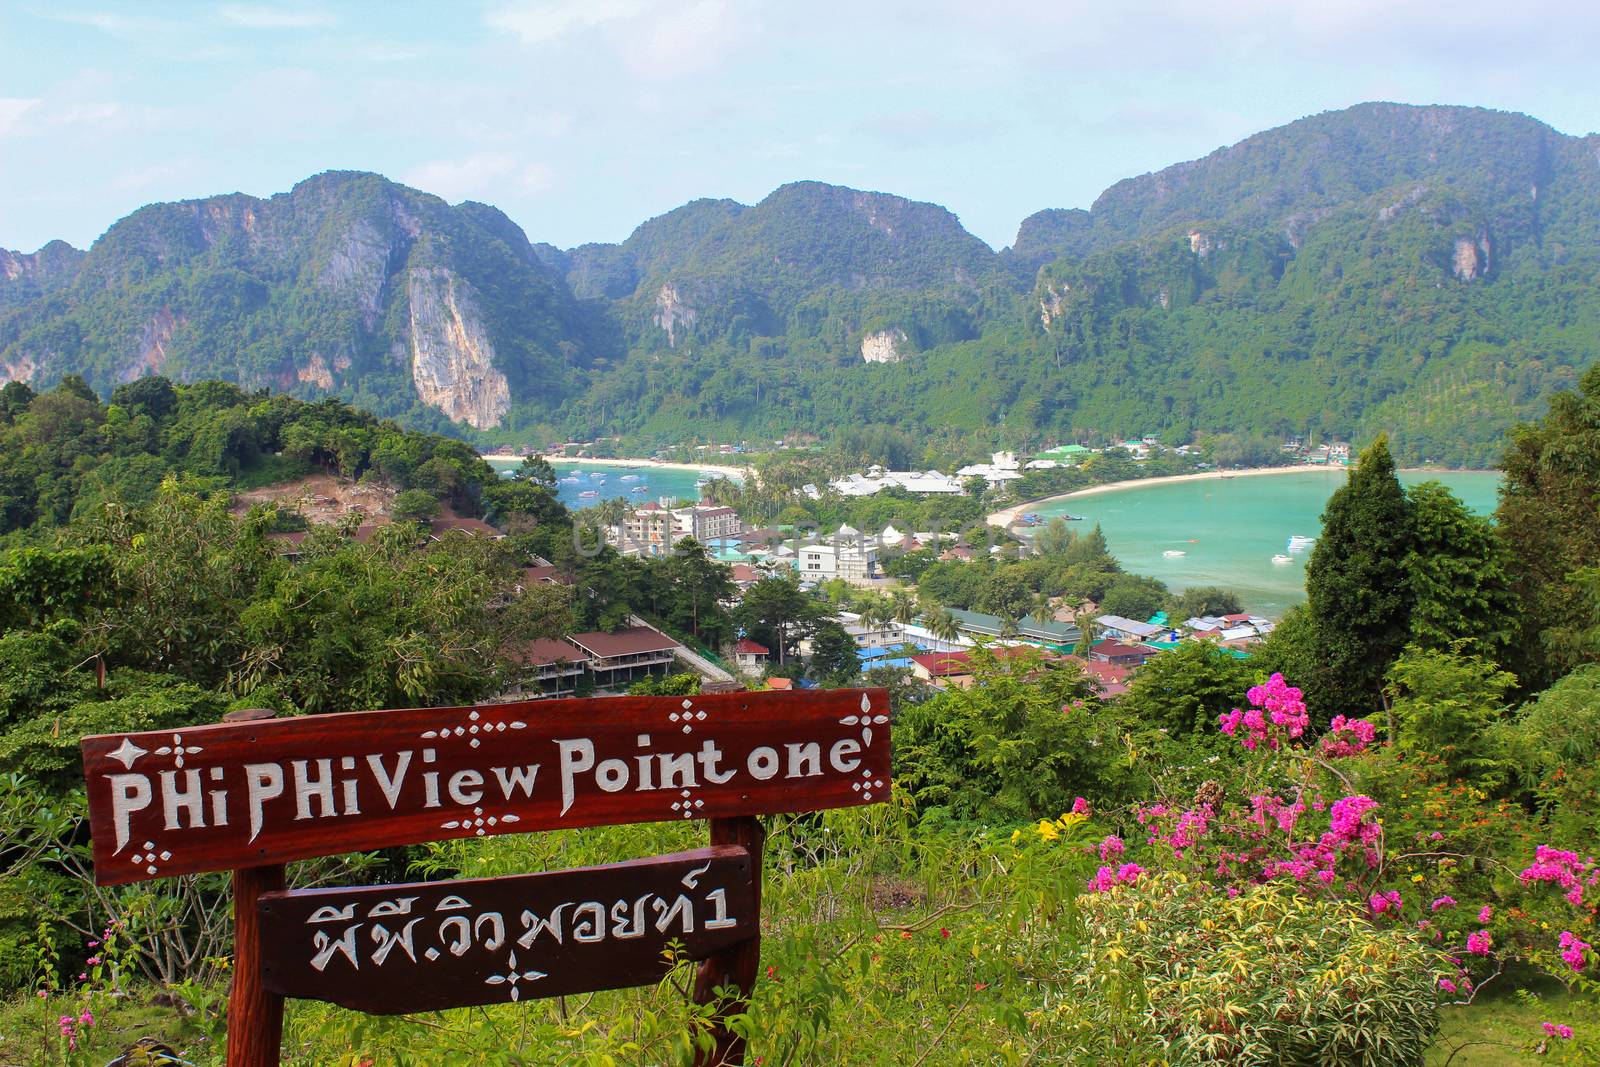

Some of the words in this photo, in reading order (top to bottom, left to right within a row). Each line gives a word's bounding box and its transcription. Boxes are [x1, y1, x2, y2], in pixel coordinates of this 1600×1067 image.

[102, 767, 229, 856] PHi
[552, 734, 738, 818] Point
[747, 738, 863, 781] one
